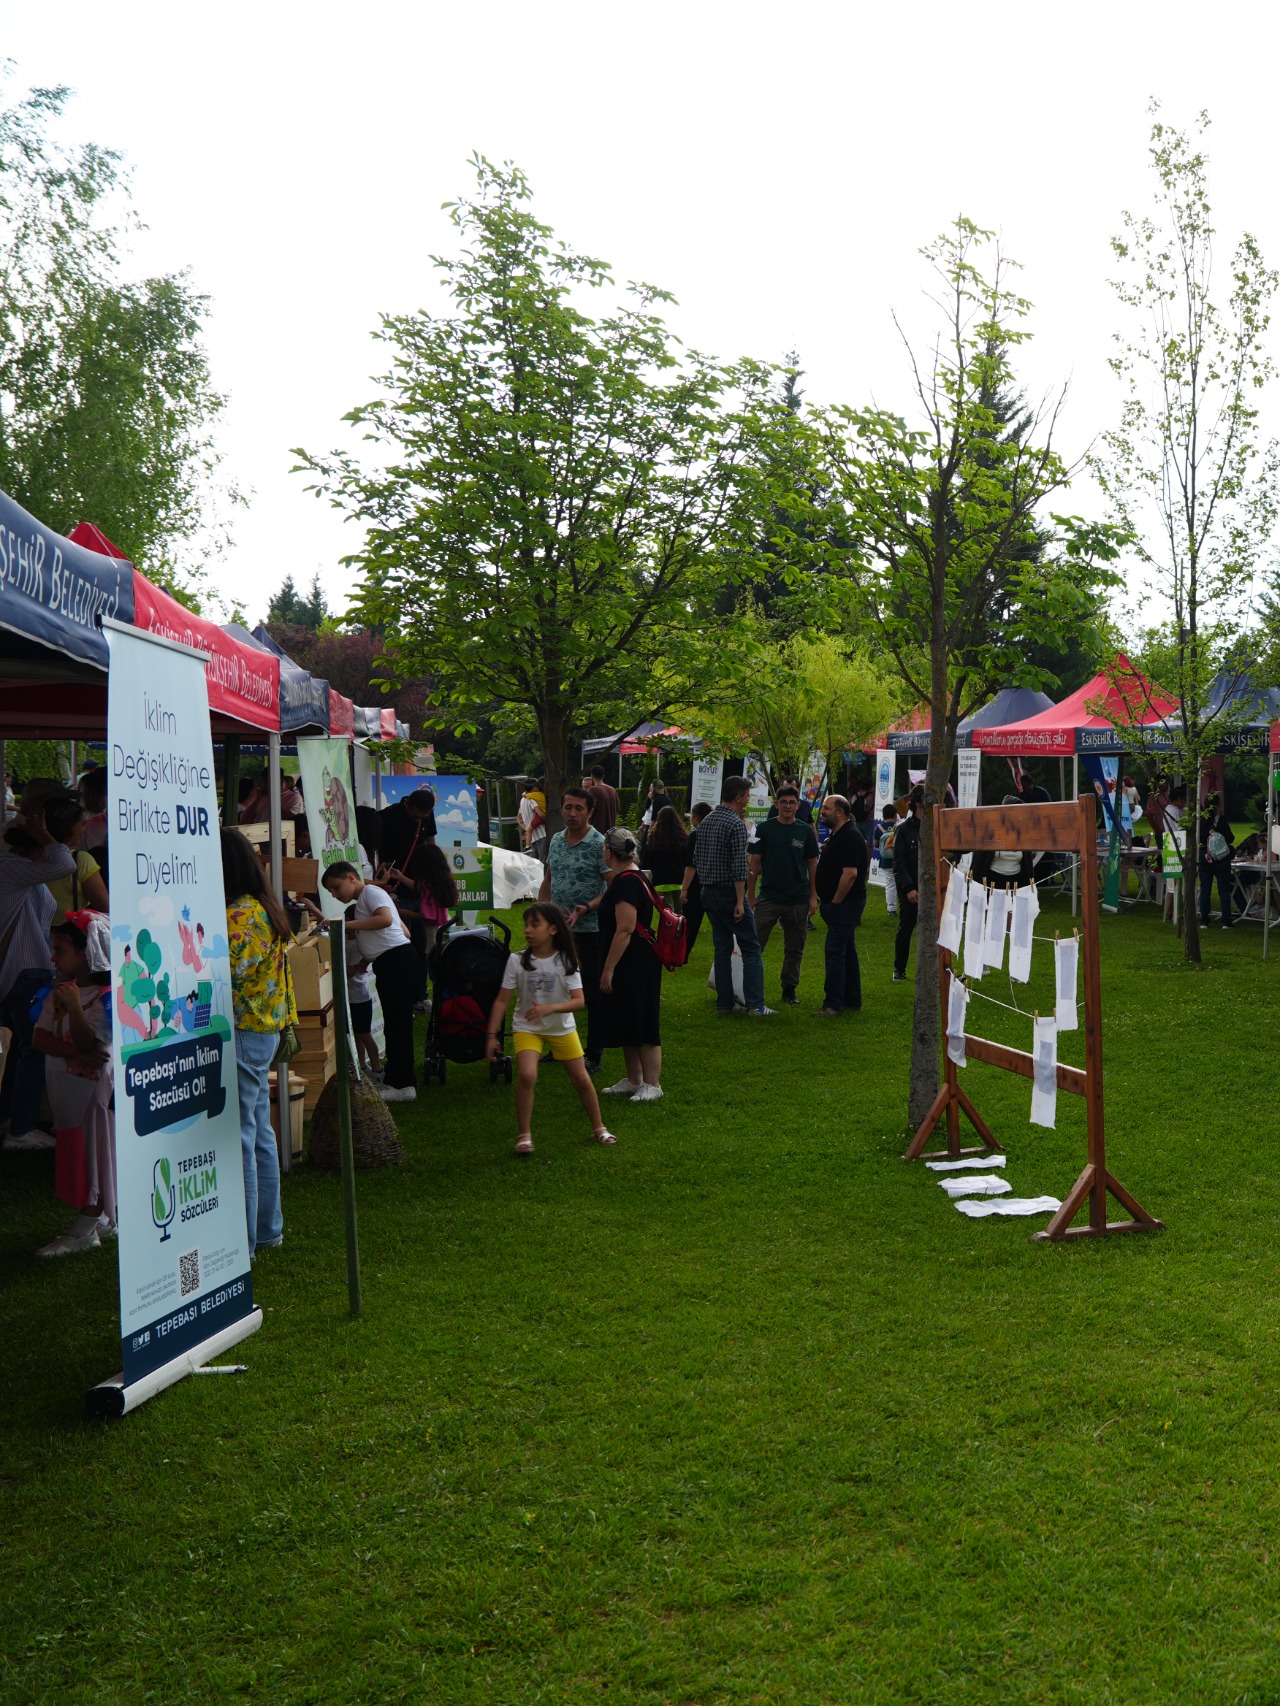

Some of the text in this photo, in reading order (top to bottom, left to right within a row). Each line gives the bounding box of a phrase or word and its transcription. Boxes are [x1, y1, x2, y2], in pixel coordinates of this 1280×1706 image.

[144, 692, 177, 736] İklim
[113, 744, 210, 795] Değişikliğine
[118, 798, 210, 836] Birlikte DUR
[136, 853, 197, 893] Diyelim!
[454, 880, 466, 890] BB
[195, 1045, 219, 1068] İklim
[150, 1079, 206, 1111] Sözcüsü Ol!
[177, 1150, 216, 1174] TEPEBAŞI
